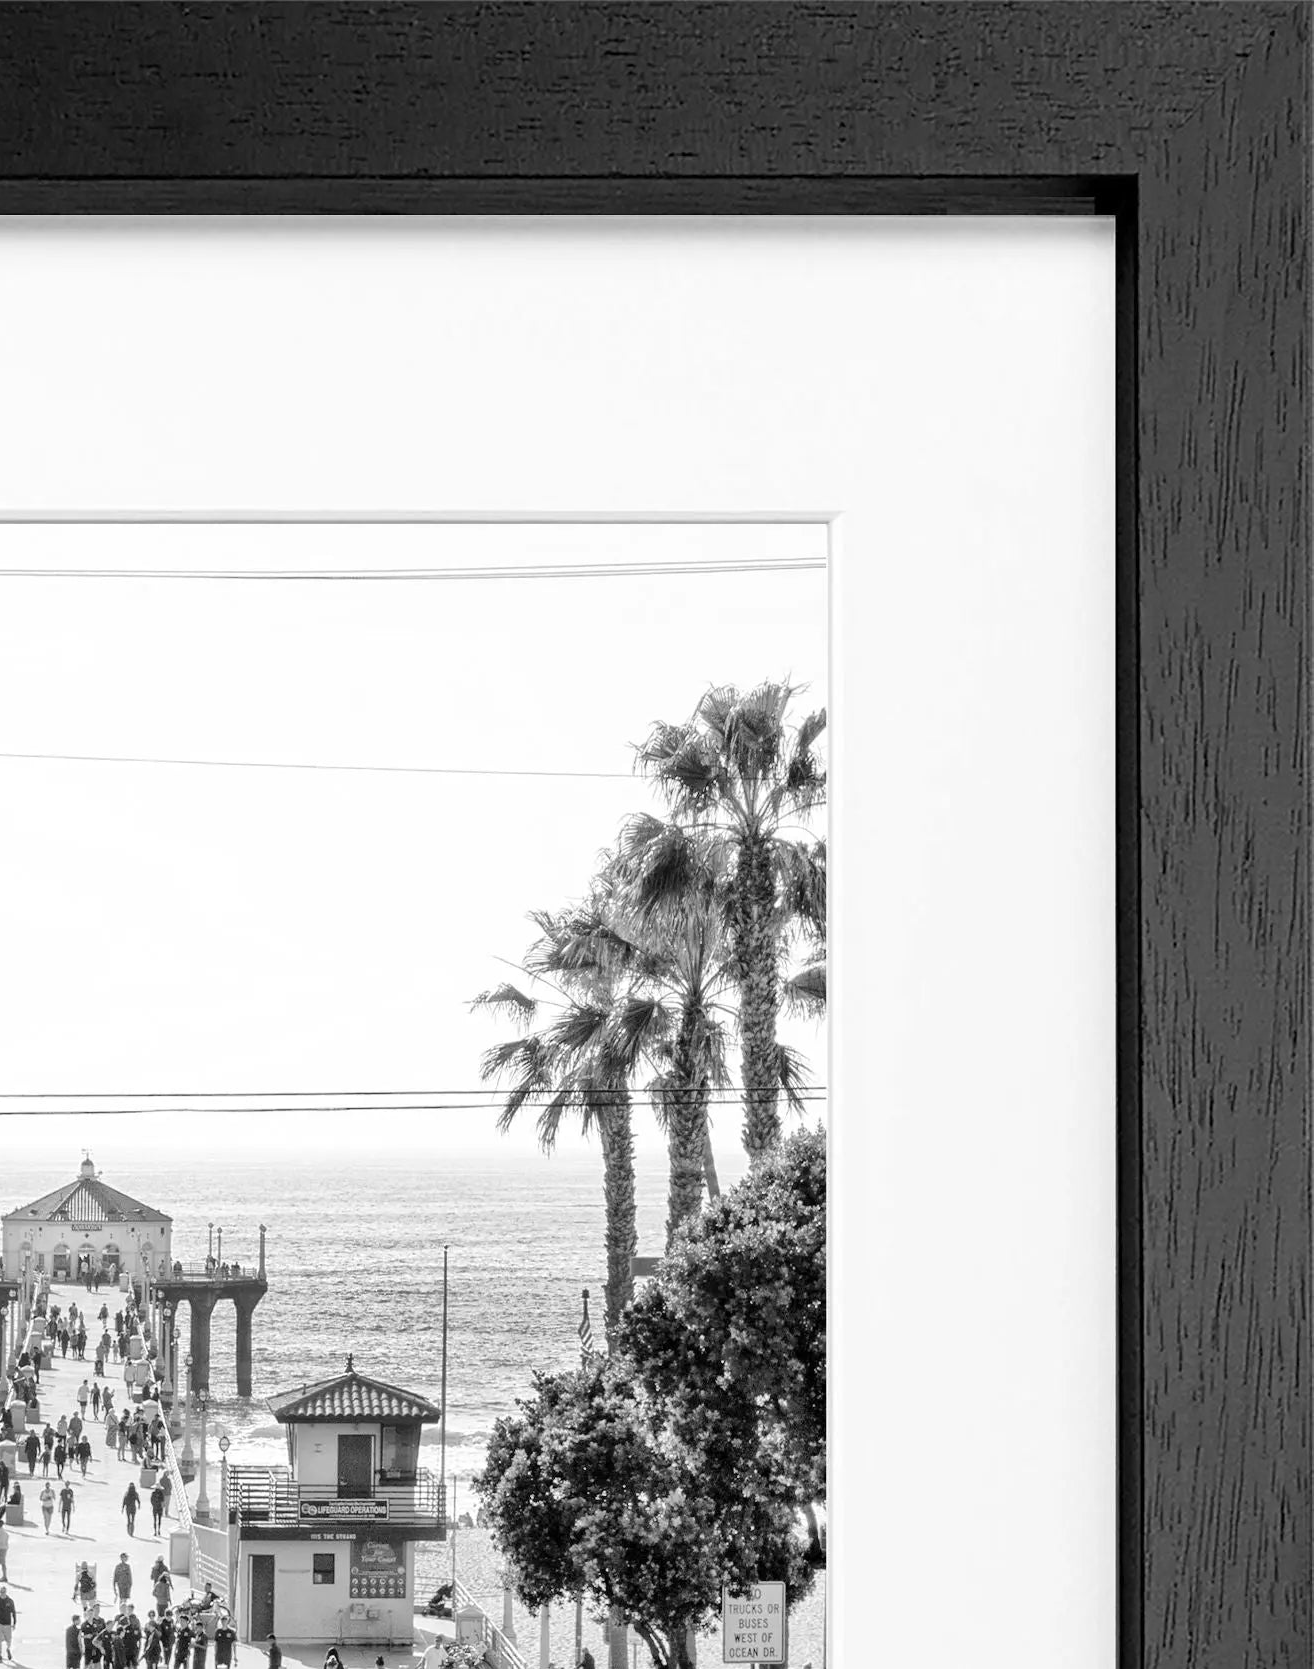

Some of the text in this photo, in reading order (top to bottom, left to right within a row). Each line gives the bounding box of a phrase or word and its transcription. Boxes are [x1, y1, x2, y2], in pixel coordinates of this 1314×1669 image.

[317, 1506, 386, 1514] LIFEGUARD OPERATIONS
[728, 1603, 779, 1615] TRUCKS OR
[738, 1618, 769, 1629] BUSES
[734, 1632, 774, 1643] WEST OF
[728, 1647, 759, 1658] OCEAN
